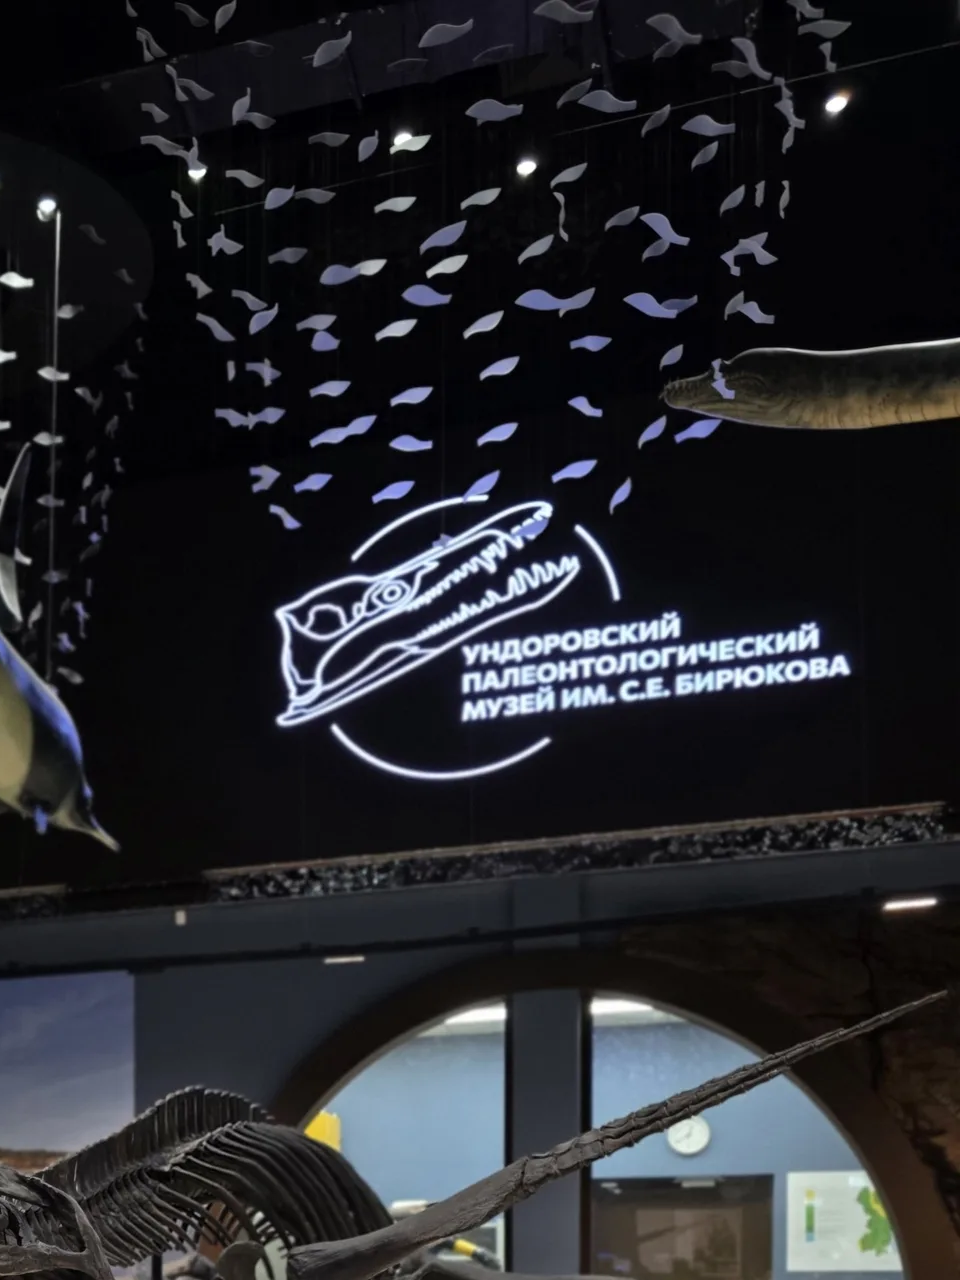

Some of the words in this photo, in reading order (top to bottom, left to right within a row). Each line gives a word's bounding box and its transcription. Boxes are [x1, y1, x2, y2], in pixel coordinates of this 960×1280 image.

[461, 611, 681, 666] УНДОРОВСКИЙ
[461, 622, 820, 694] ПАЛЕОНТОЛОГИЧЕСКИЙ
[461, 685, 556, 722] МУЗЕЙ
[561, 683, 616, 709] ИМ.
[619, 677, 672, 702] С.Е.
[675, 654, 852, 696] БИРЮКОВА
